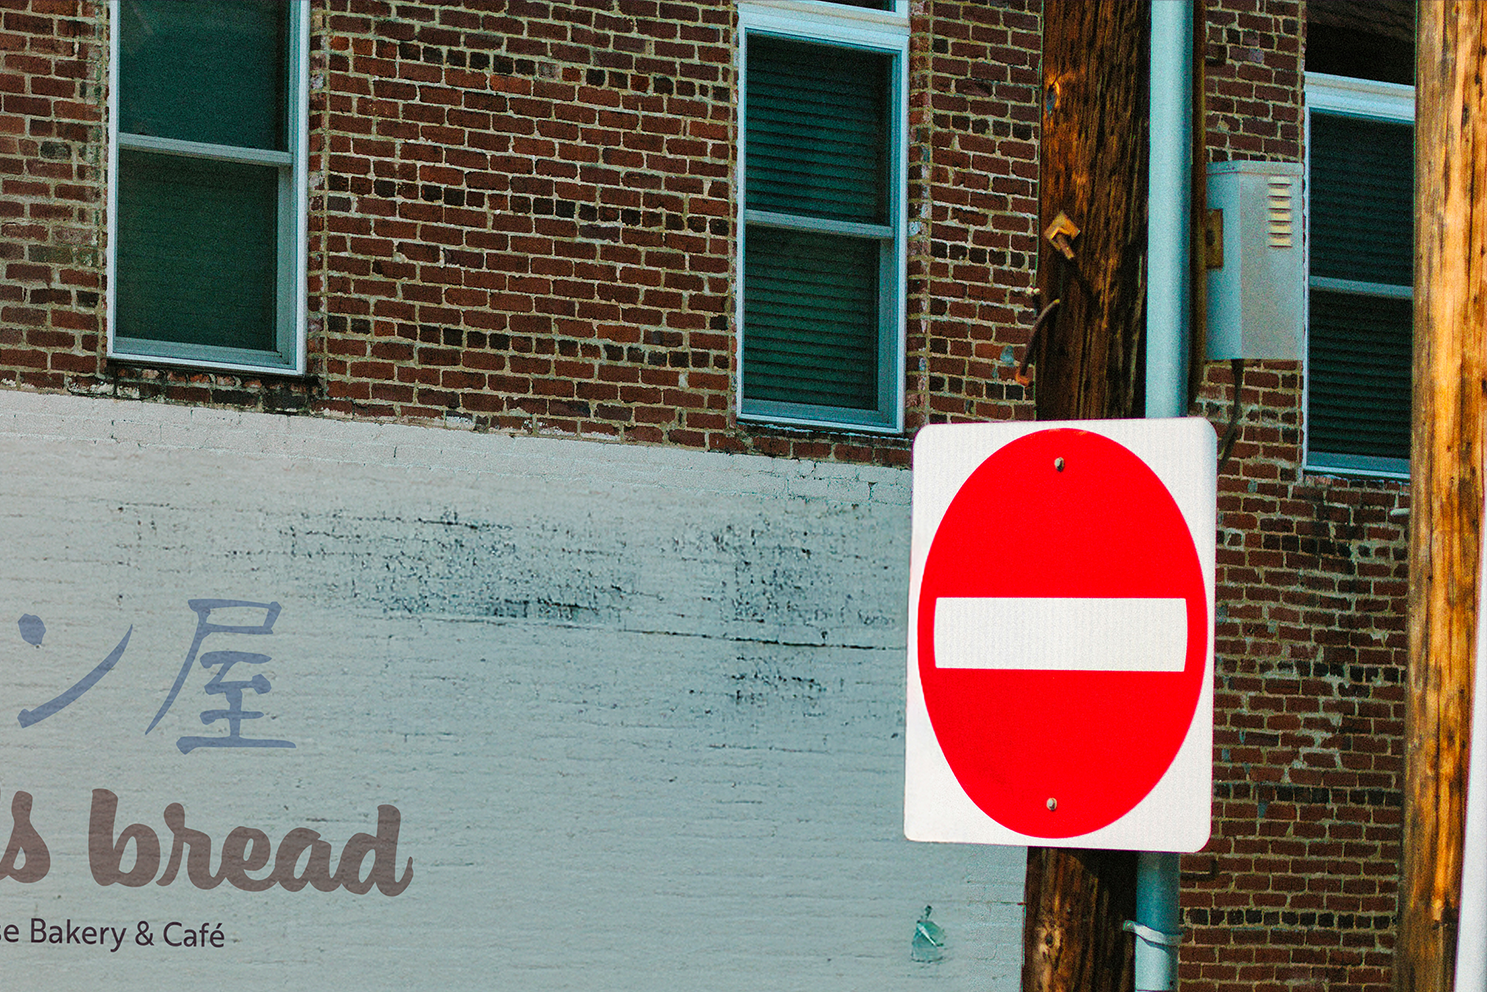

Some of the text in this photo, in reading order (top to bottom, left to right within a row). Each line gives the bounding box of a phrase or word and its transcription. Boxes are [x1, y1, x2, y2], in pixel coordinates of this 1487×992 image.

[88, 788, 414, 897] bread
[29, 917, 126, 953] Bakery
[133, 920, 155, 947] &
[163, 921, 226, 949] Café
